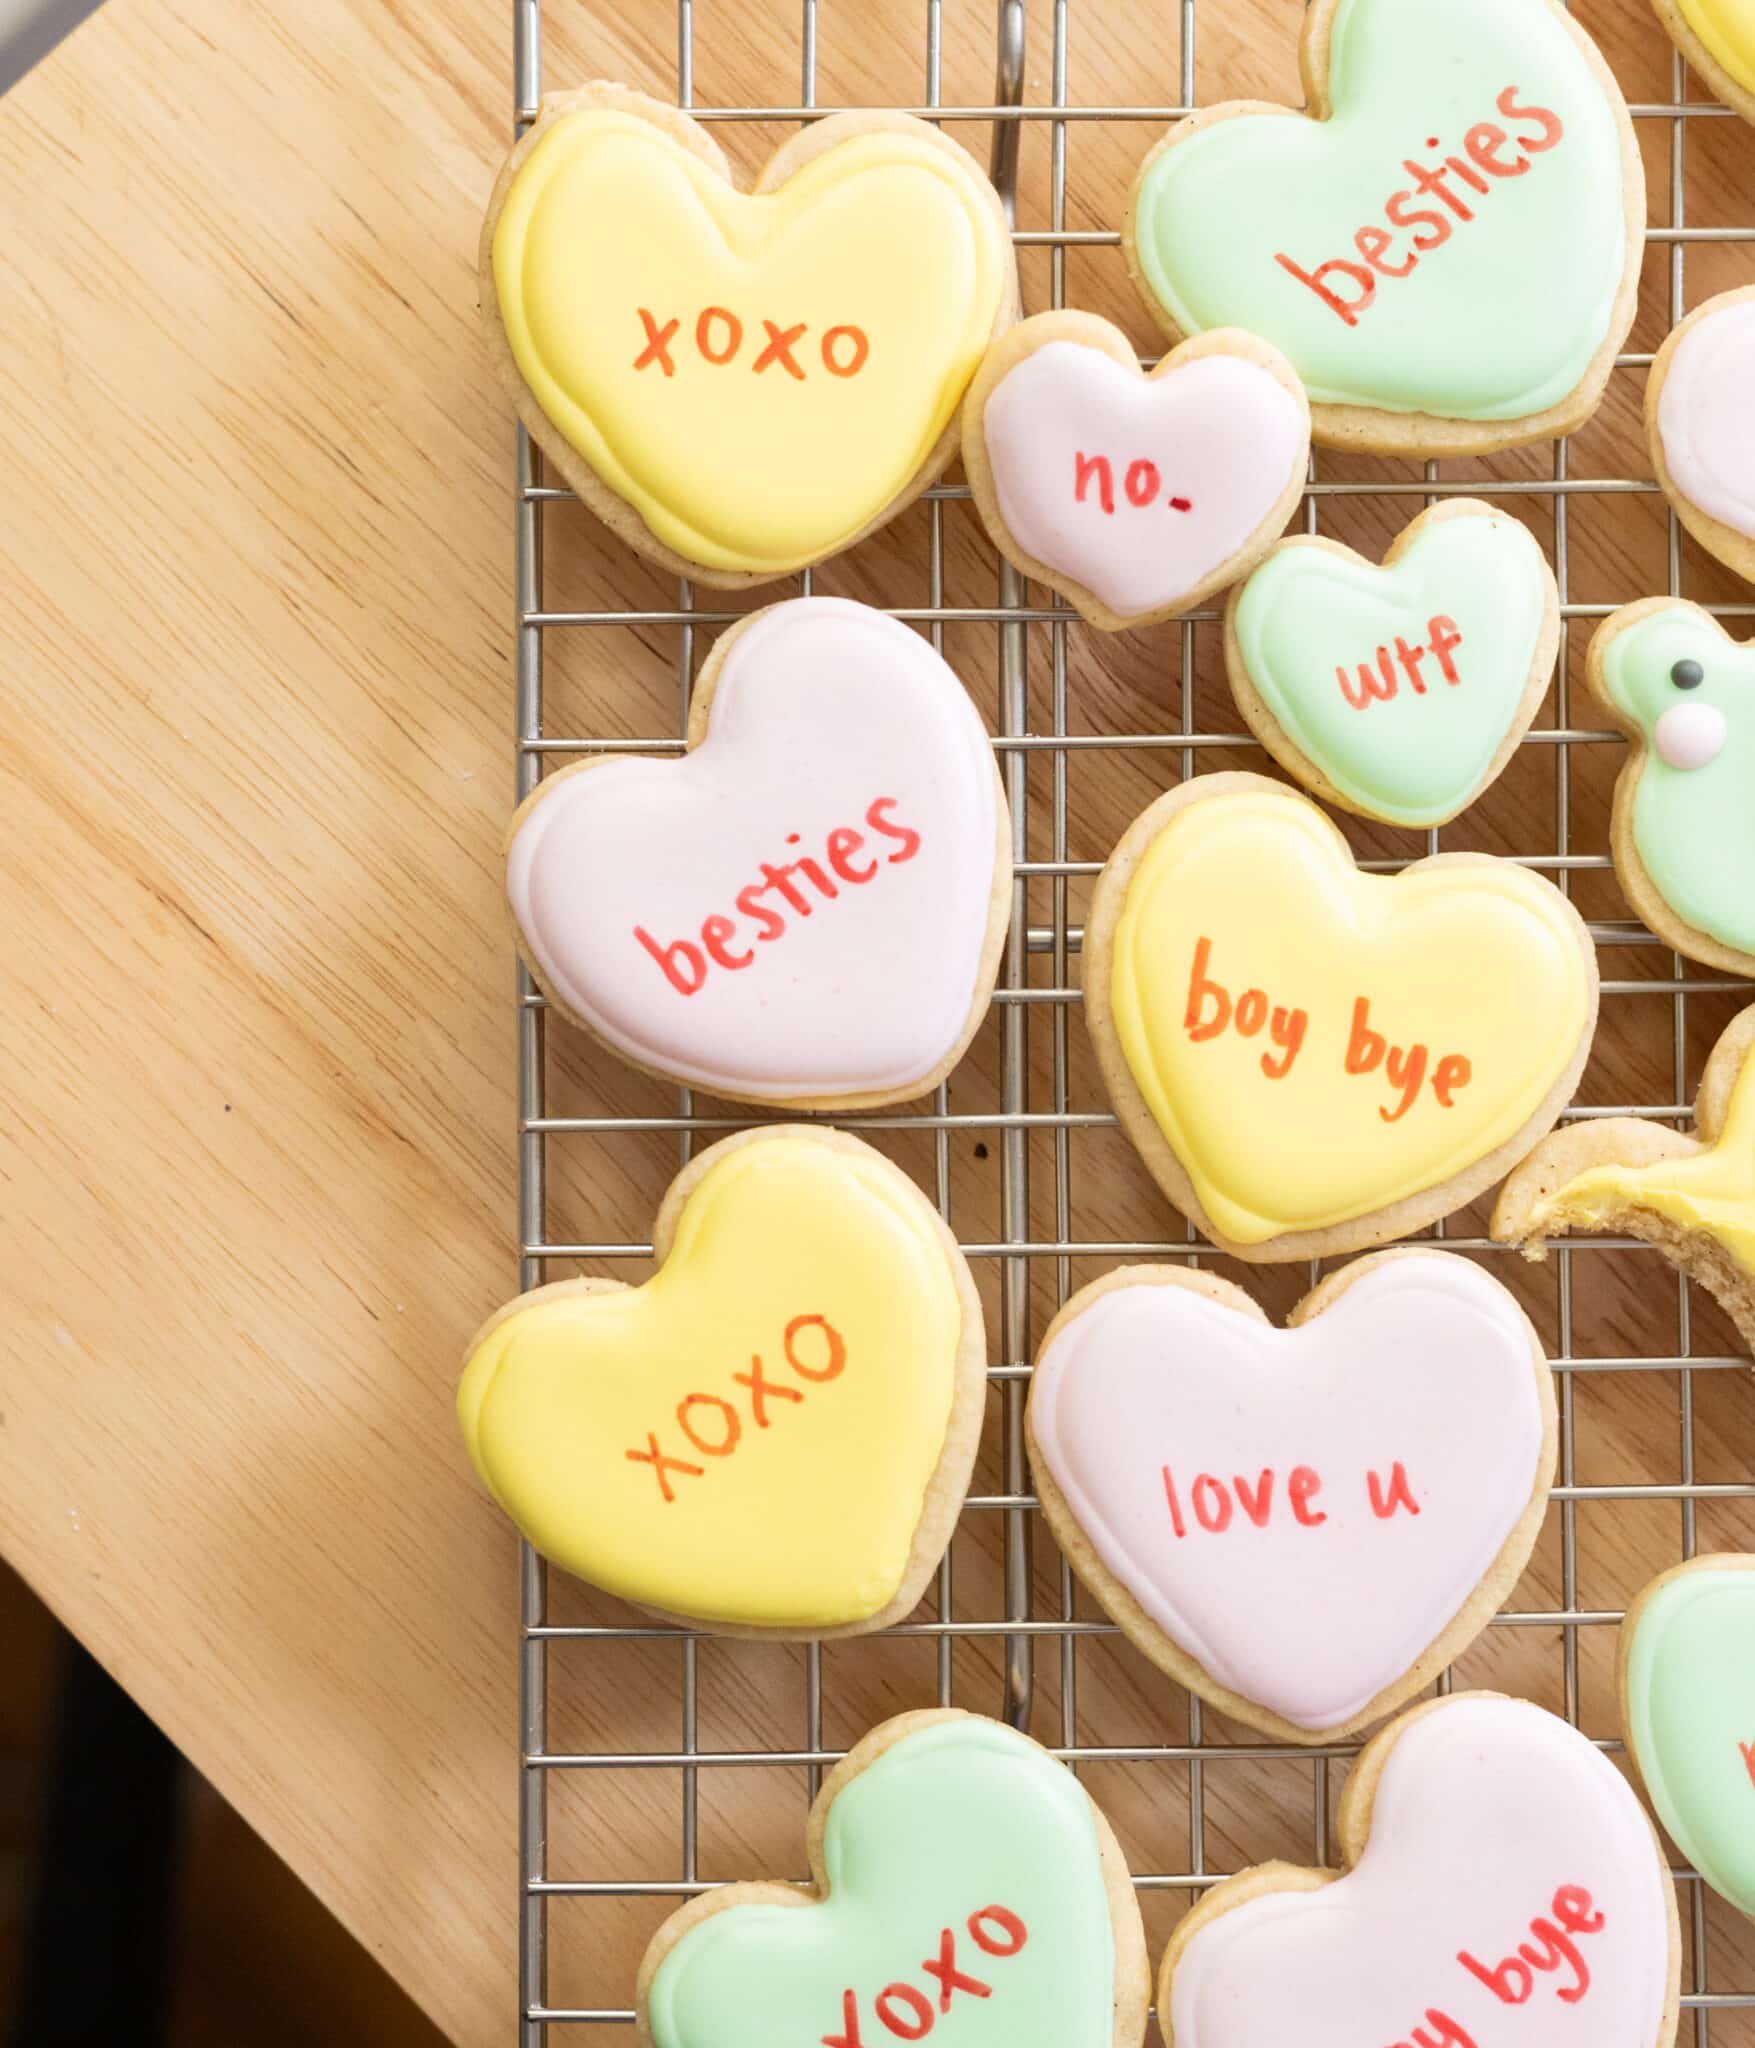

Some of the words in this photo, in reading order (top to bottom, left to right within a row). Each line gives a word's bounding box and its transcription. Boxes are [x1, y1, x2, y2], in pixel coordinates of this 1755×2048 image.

[1275, 85, 1563, 328] besties
[1074, 451, 1193, 516] no.
[1335, 615, 1463, 711] wtf
[632, 796, 922, 997] besties
[1183, 936, 1308, 1079] boy
[1344, 996, 1471, 1123] bye
[1162, 1465, 1328, 1539] love
[1366, 1461, 1421, 1520] u
[1455, 1884, 1606, 2005] bye
